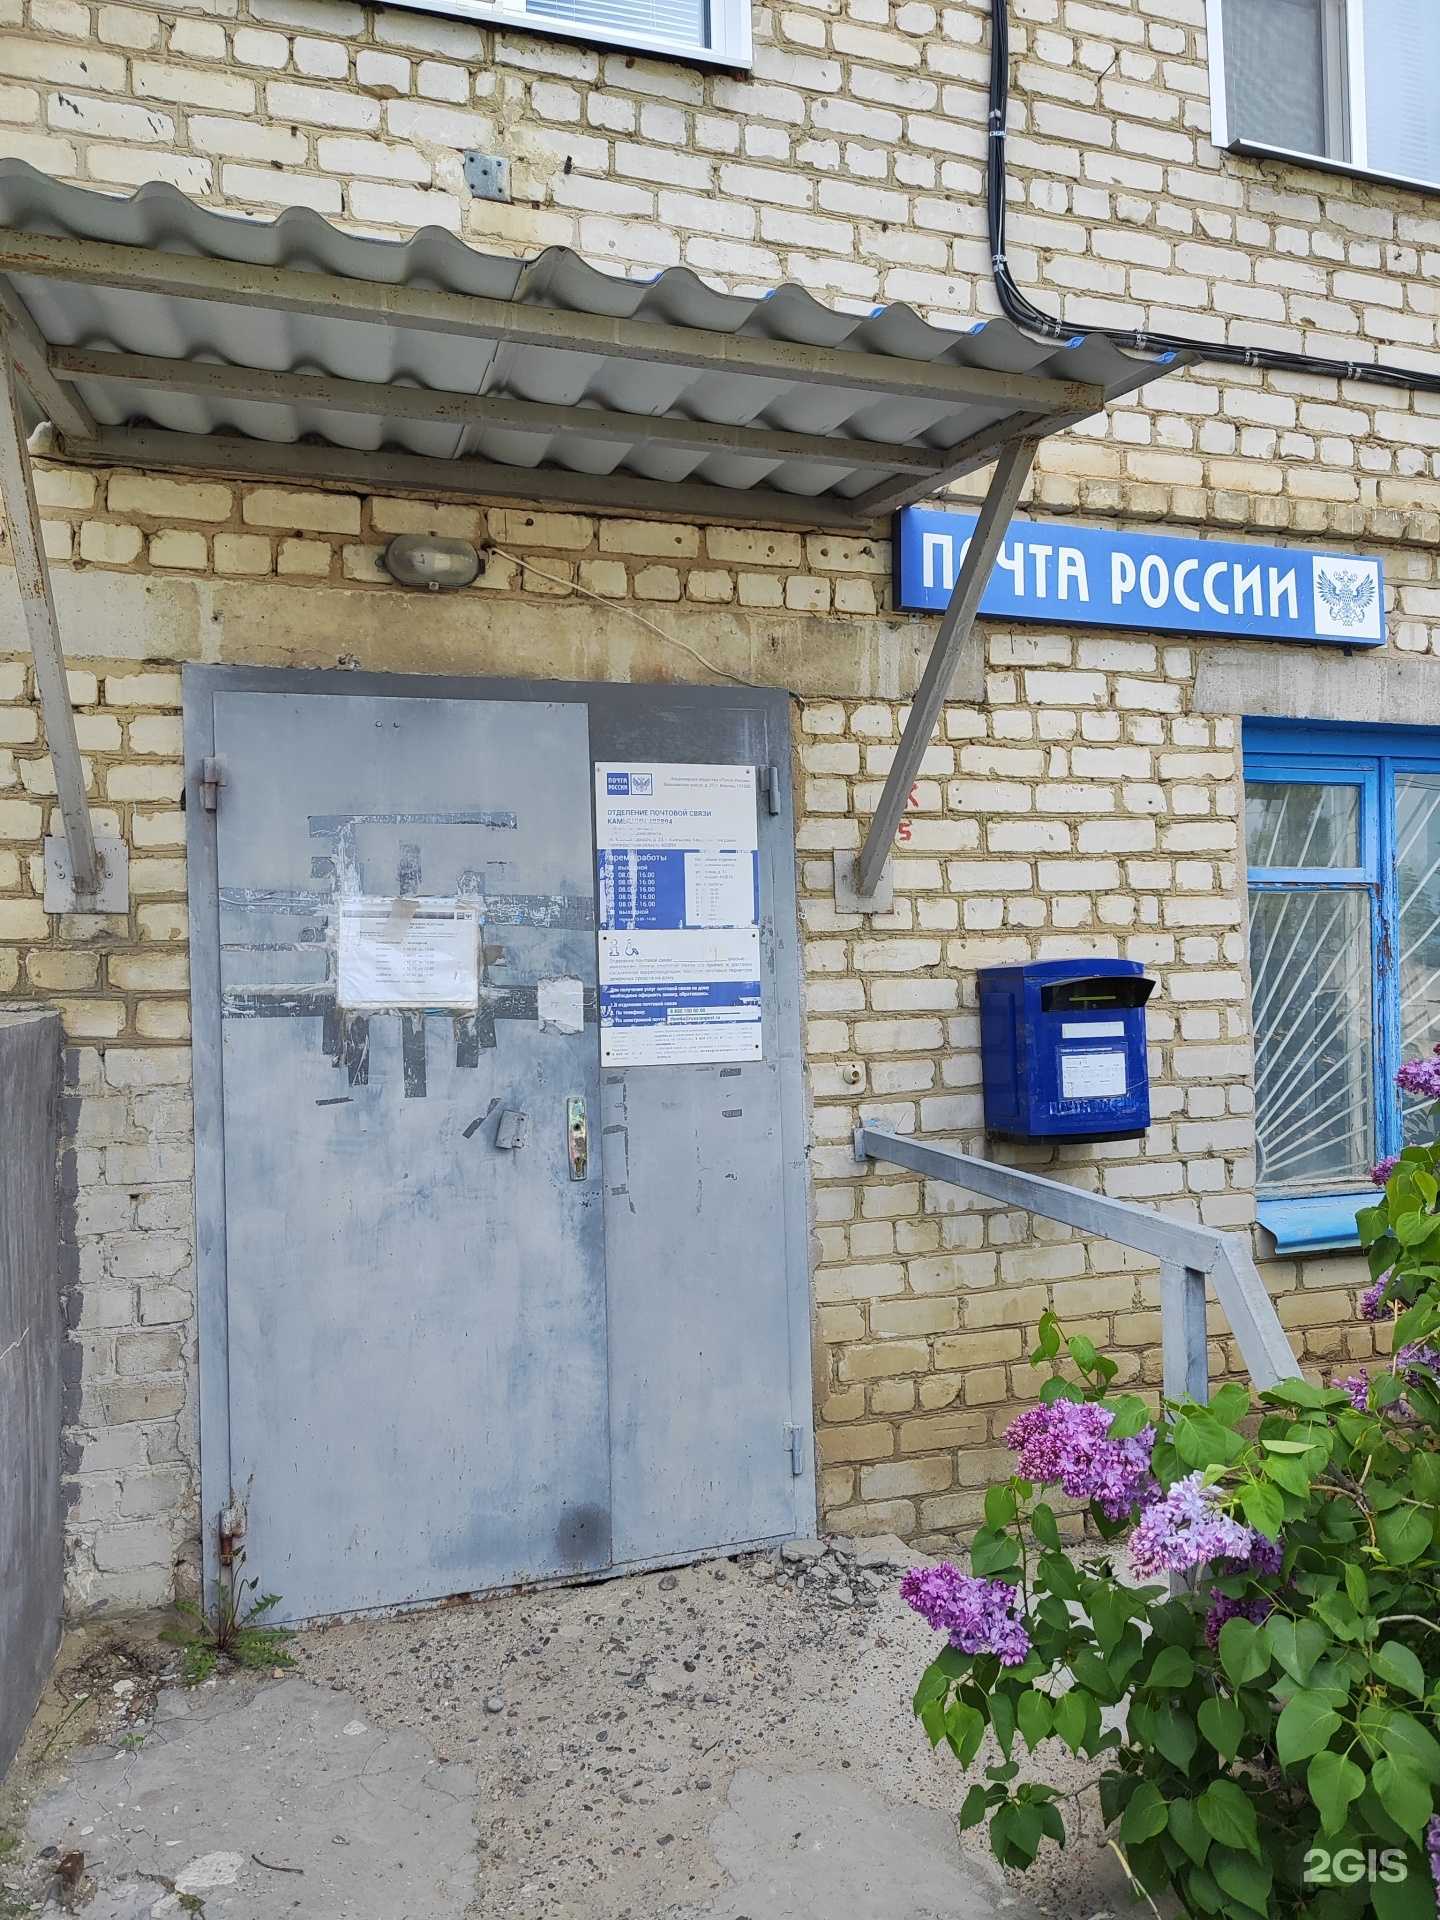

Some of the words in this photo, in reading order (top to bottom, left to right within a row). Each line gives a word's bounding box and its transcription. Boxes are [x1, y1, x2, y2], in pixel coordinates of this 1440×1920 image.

[922, 532, 1090, 602] ПЧТА
[1111, 551, 1299, 619] РОССИИ
[607, 809, 649, 817] ОТДЕЛЕНИЕ
[650, 808, 688, 817] ПОЧТОВОЙ
[689, 809, 712, 817] СВЯЗИ
